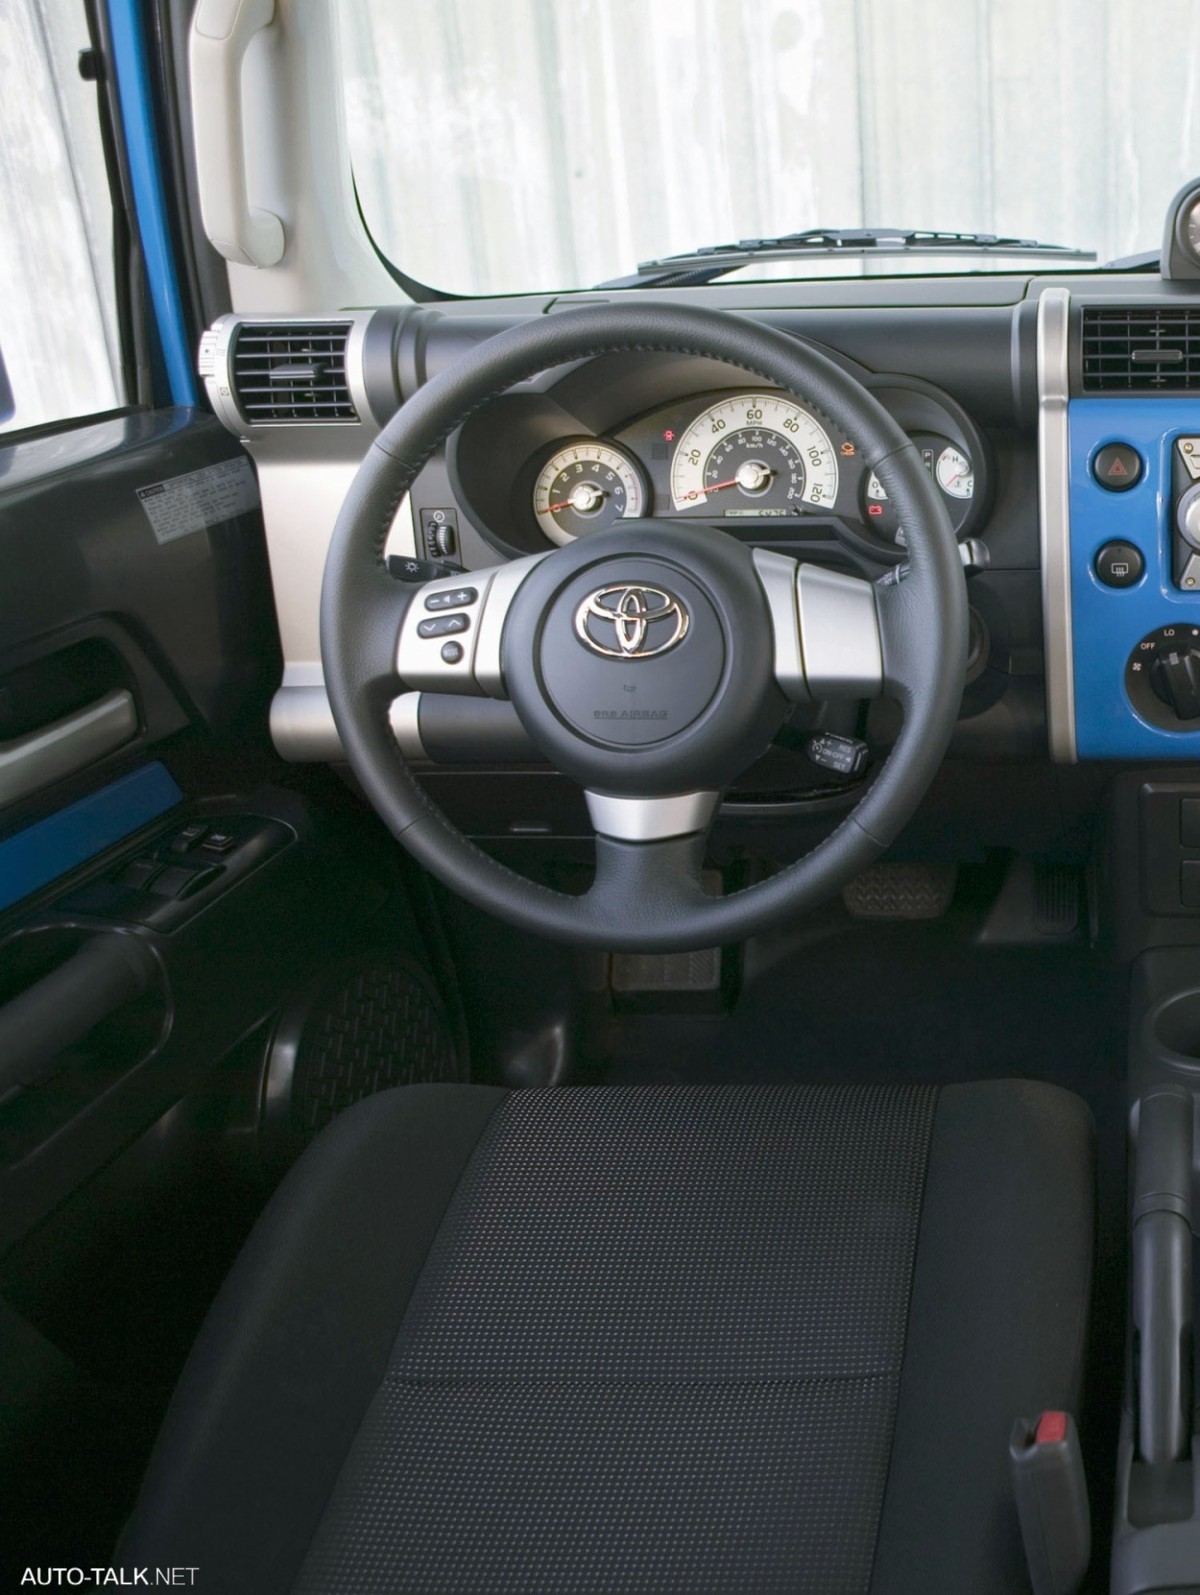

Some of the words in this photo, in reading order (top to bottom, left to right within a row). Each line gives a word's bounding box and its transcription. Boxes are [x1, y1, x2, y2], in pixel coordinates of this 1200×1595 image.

[746, 409, 763, 420] 60
[711, 419, 726, 434] 40
[783, 418, 799, 433] 80
[688, 449, 701, 466] 20
[807, 445, 822, 467] 100
[575, 464, 584, 474] 3
[591, 464, 600, 473] 4
[560, 472, 570, 482] 2
[605, 471, 616, 481] 5
[614, 486, 624, 495] 6
[810, 483, 823, 503] 120
[614, 504, 624, 512] 7
[1163, 629, 1175, 637] LO
[1140, 642, 1156, 650] OFF
